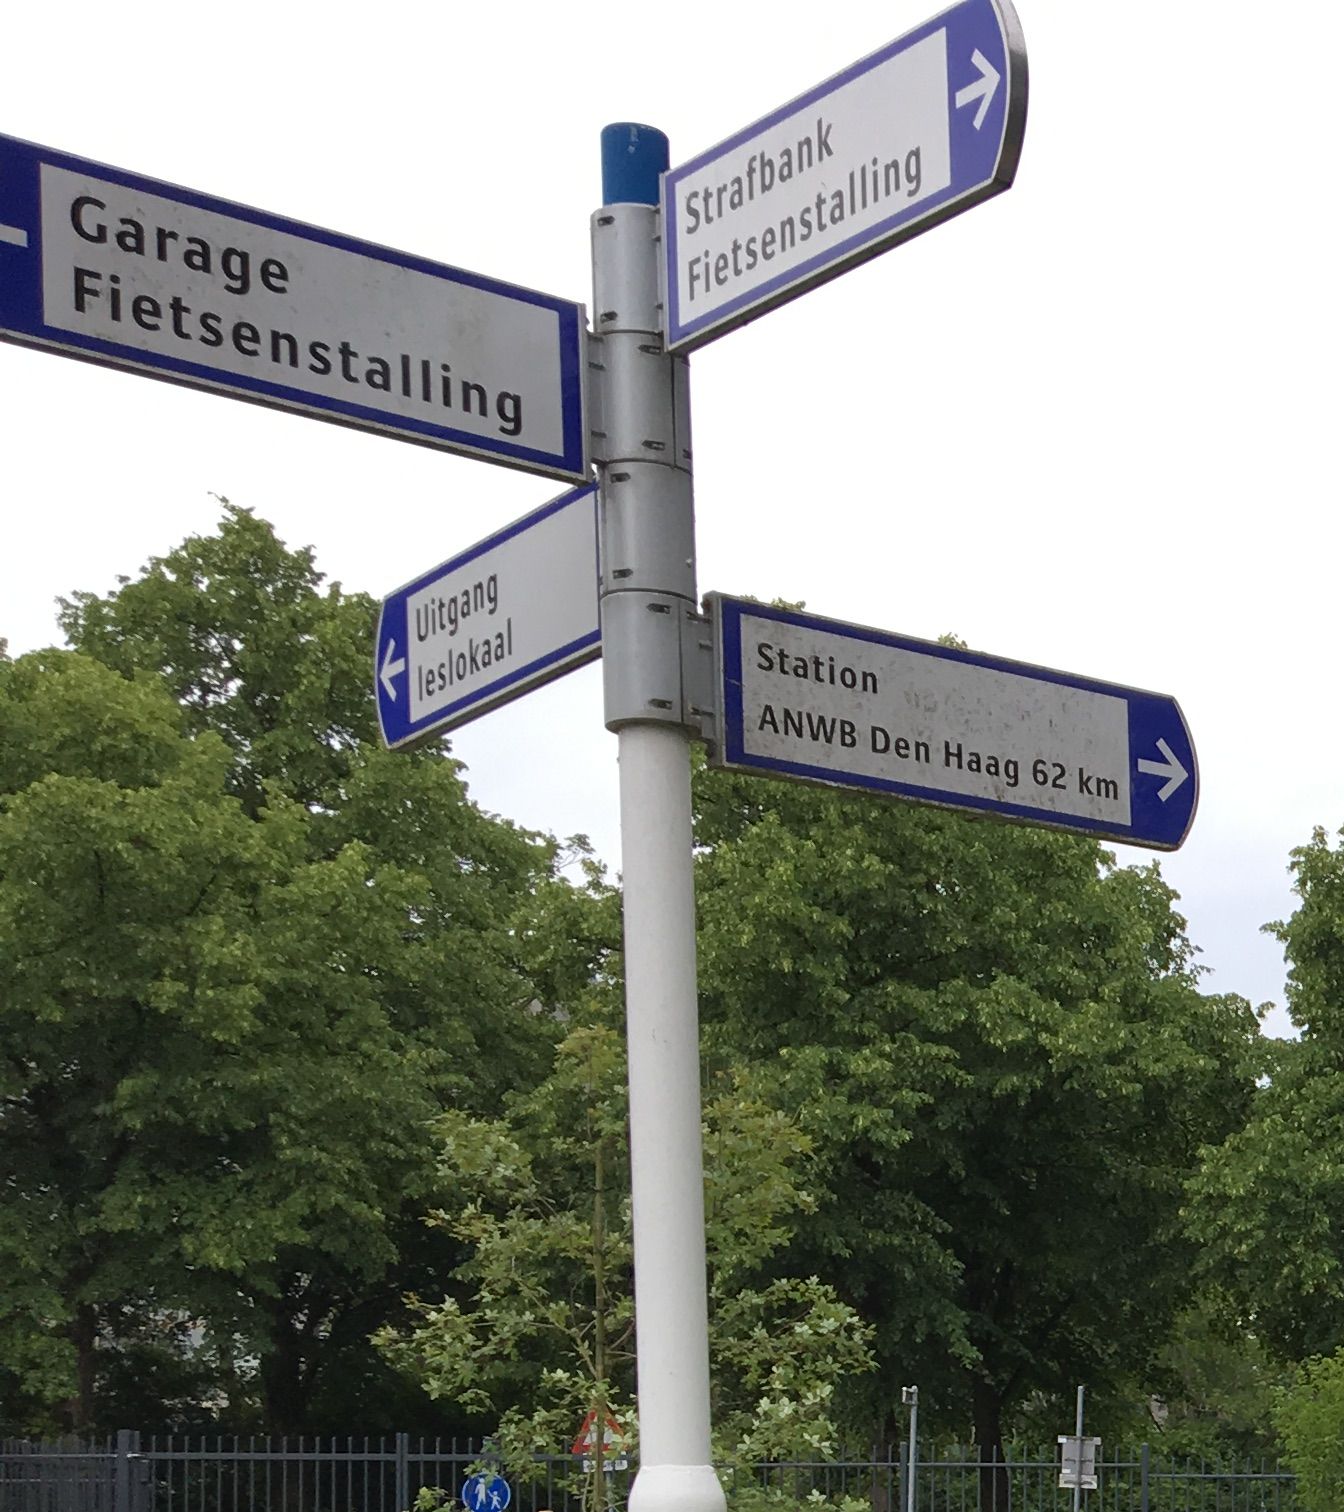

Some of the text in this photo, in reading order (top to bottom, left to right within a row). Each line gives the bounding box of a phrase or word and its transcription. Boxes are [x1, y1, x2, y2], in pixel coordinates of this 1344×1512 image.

[684, 117, 834, 236] Strafbank
[687, 145, 922, 302] Fietsenstalling
[70, 195, 290, 296] Garage
[73, 266, 523, 437] Fietsenstalling
[416, 573, 498, 643] Uitgang
[417, 617, 513, 702] leslokaal
[756, 642, 879, 694] Station
[758, 704, 1119, 800] ANWB Den Haag 62 km
